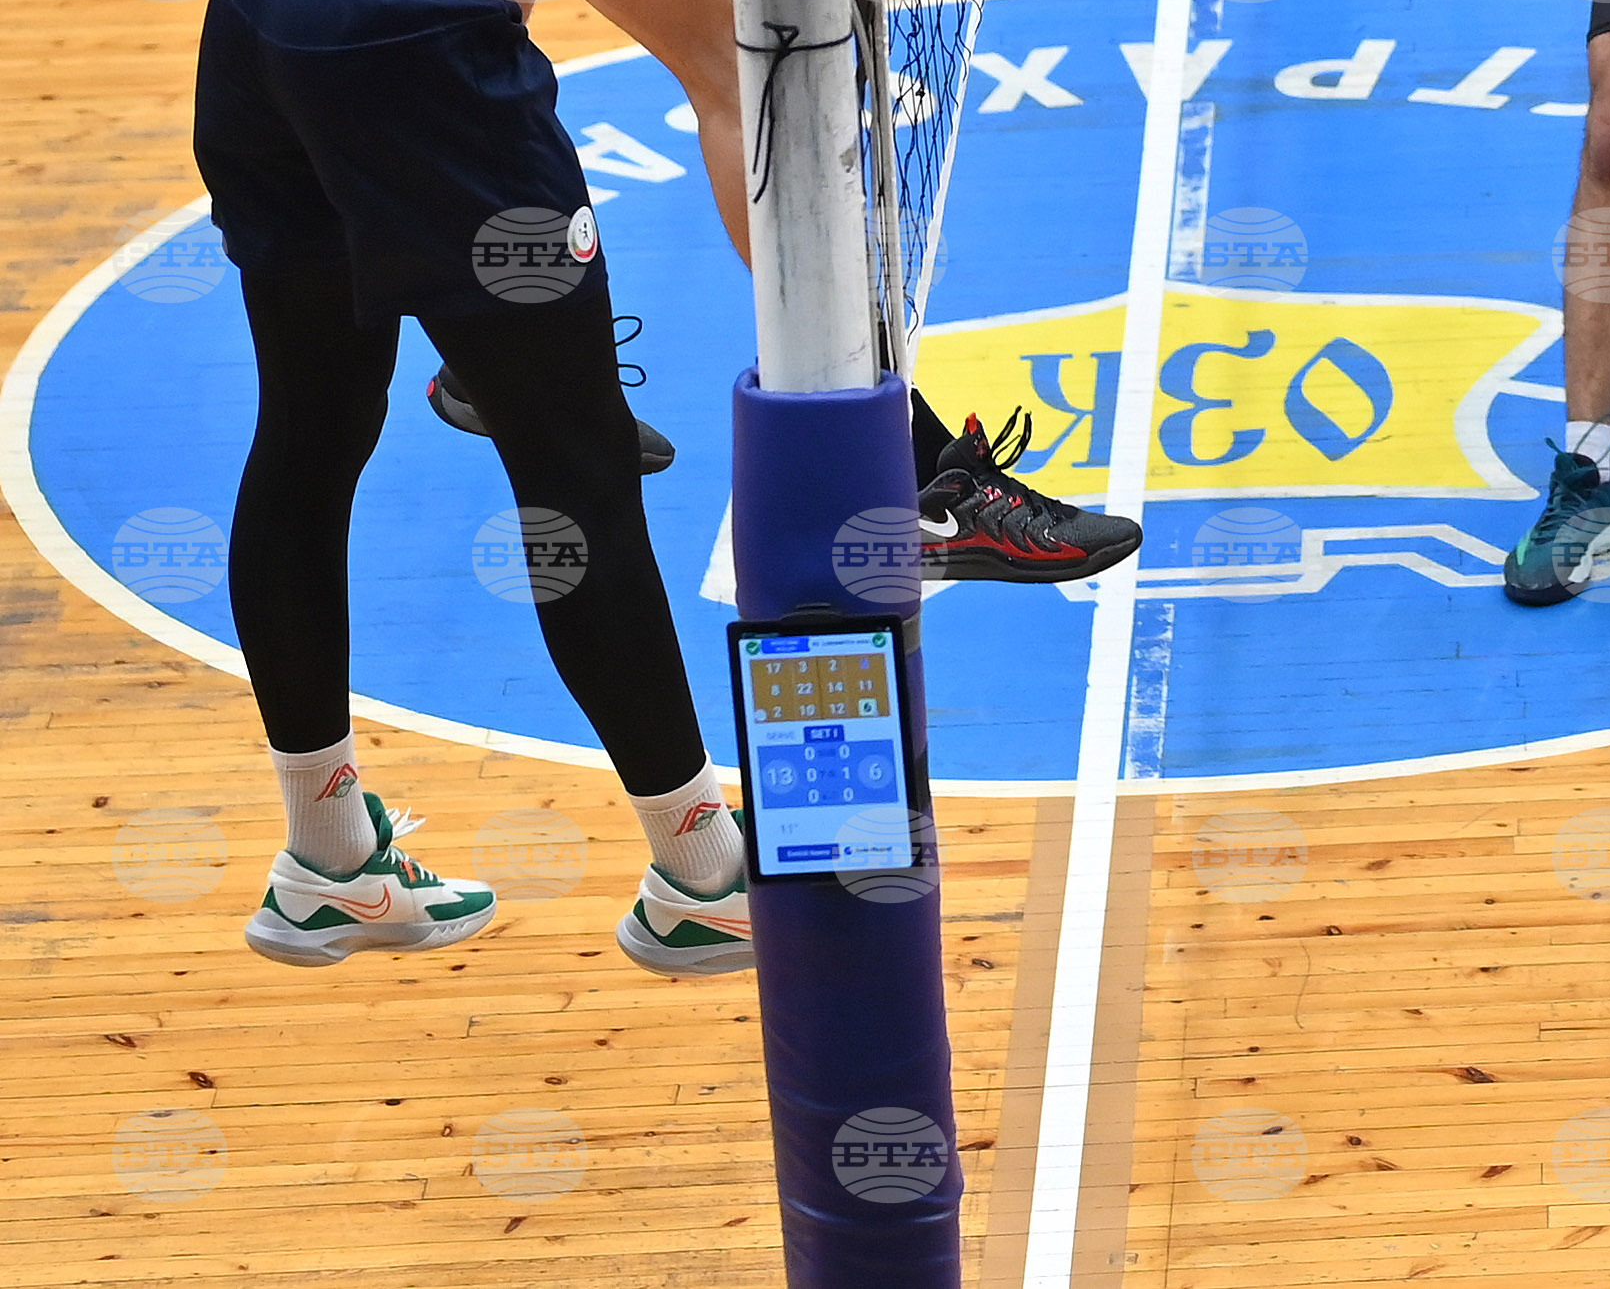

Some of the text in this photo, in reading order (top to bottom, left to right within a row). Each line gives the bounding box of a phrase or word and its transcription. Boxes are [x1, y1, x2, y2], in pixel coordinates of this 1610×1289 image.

[804, 744, 850, 761] 0 0
[767, 763, 883, 786] 13 0 1 6
[808, 787, 854, 804] 0 0
